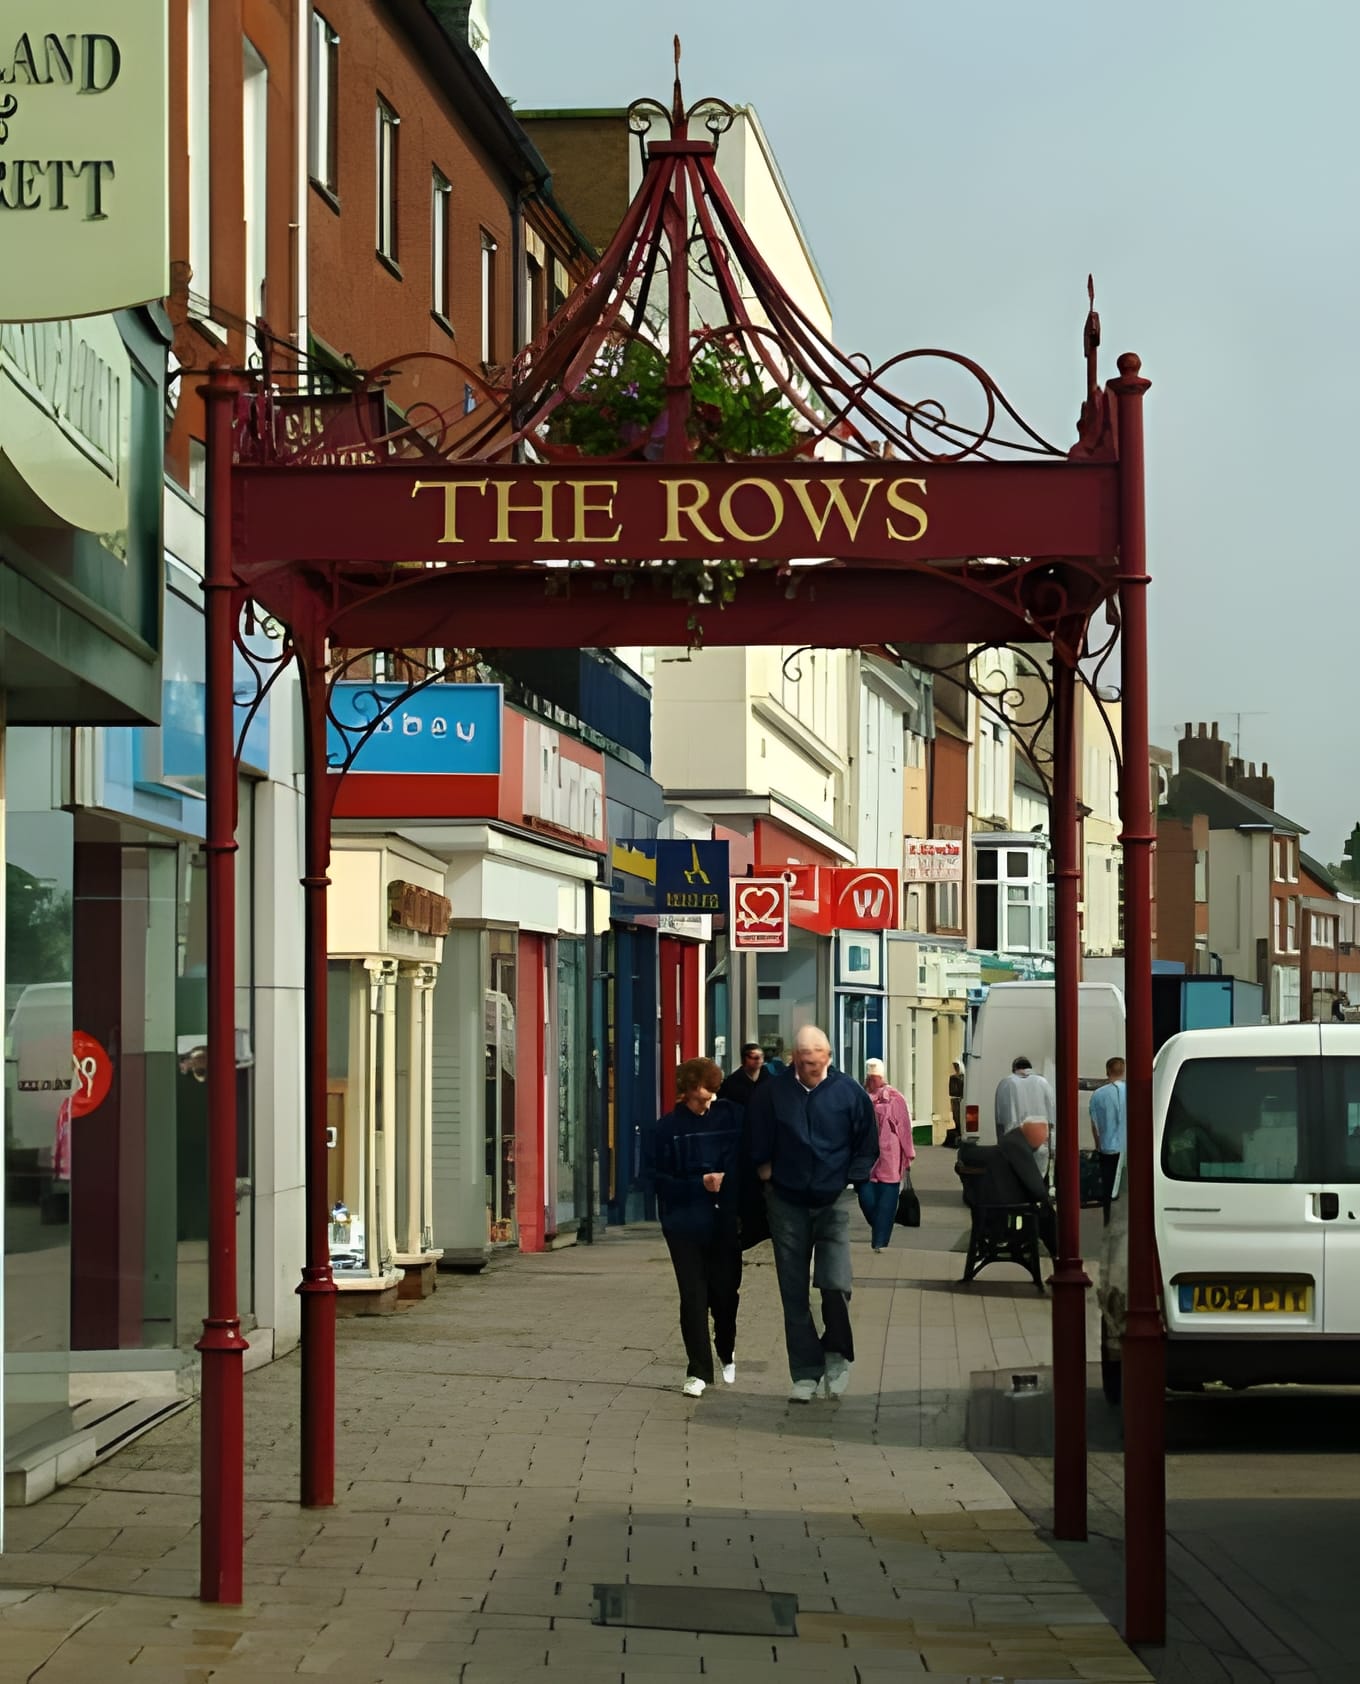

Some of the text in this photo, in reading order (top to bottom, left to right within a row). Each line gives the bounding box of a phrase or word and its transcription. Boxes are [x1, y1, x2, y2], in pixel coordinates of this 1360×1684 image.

[0, 32, 121, 95] AND
[411, 477, 929, 544] THE ROWS
